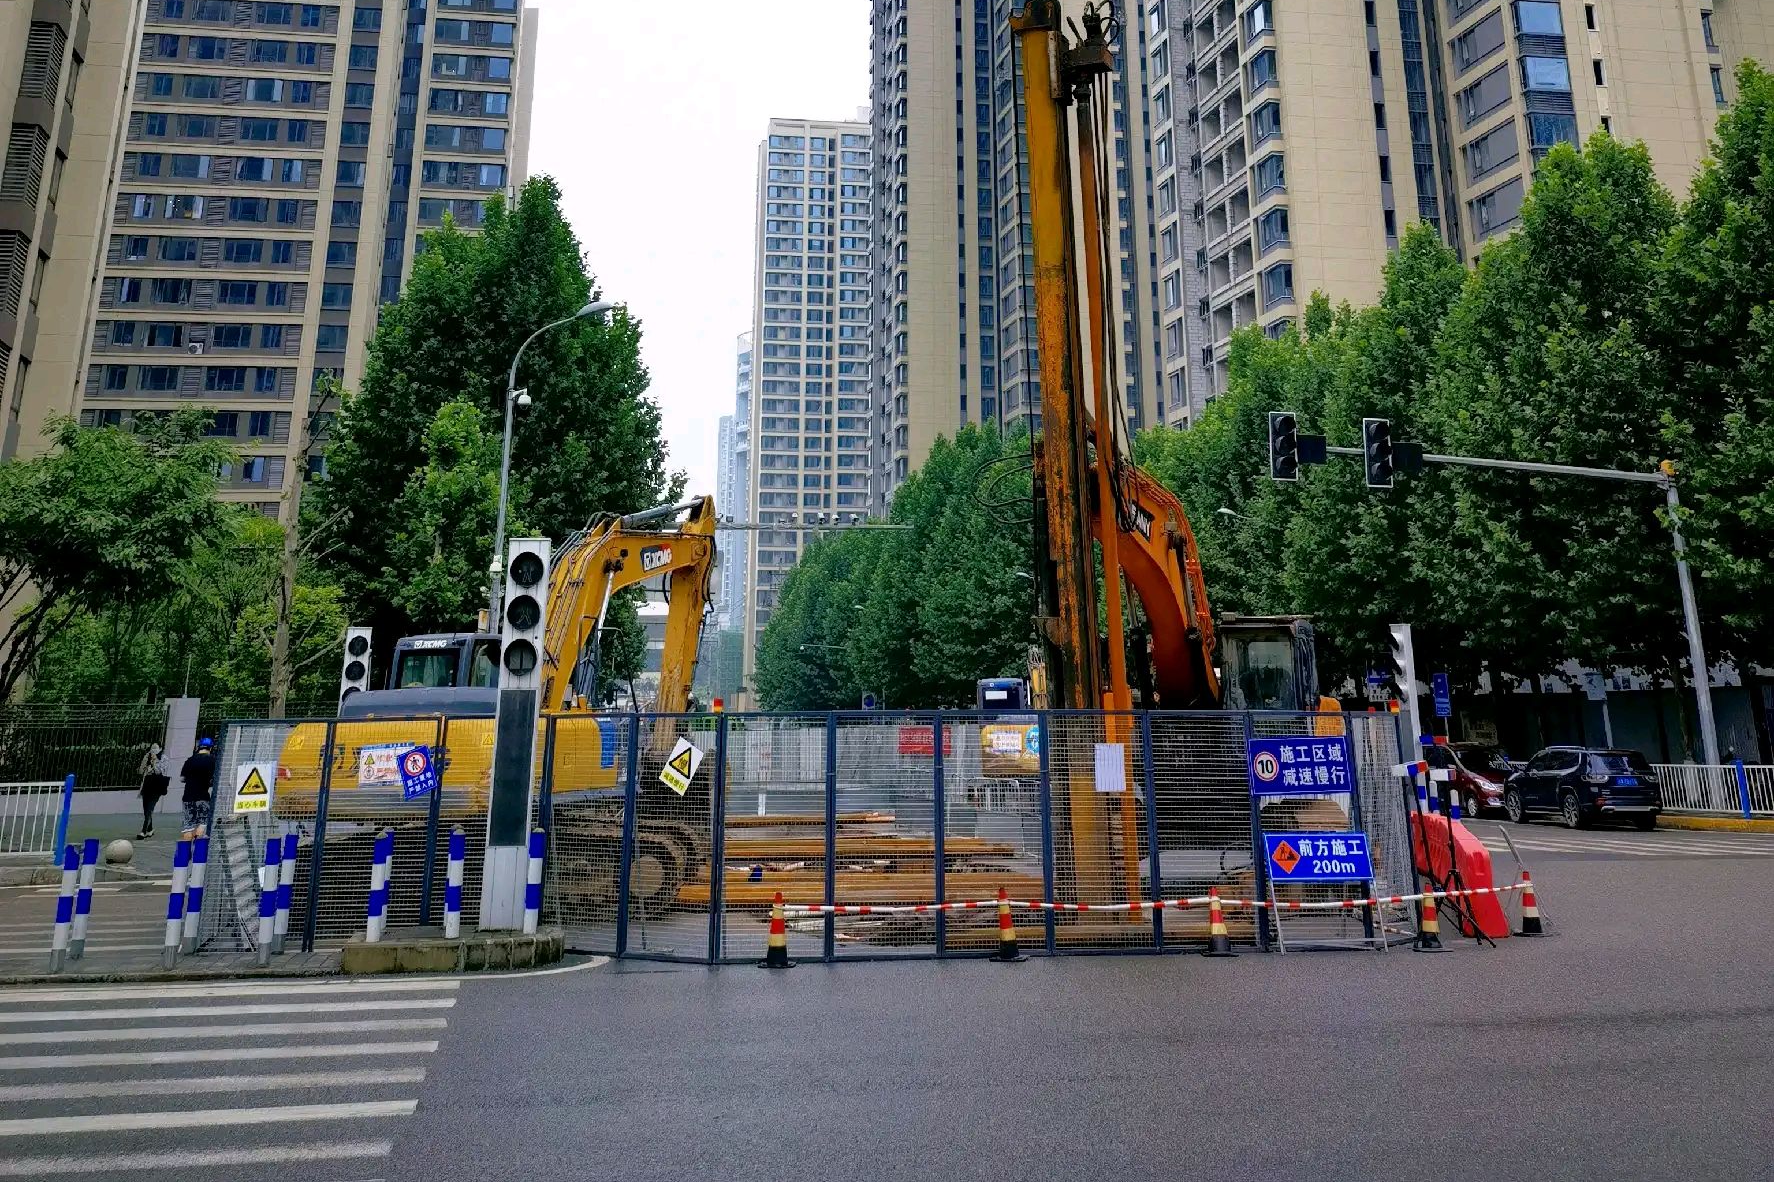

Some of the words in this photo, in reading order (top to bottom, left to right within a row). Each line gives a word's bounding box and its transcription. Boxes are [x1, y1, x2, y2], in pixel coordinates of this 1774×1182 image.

[421, 639, 448, 649] XCMG
[1279, 743, 1344, 763] 施工区域
[1257, 759, 1274, 774] 10
[1282, 766, 1345, 786] 减速慢行
[408, 780, 434, 794] 严禁入内
[1298, 838, 1364, 857] 前方施工
[1312, 859, 1356, 874] 200m
